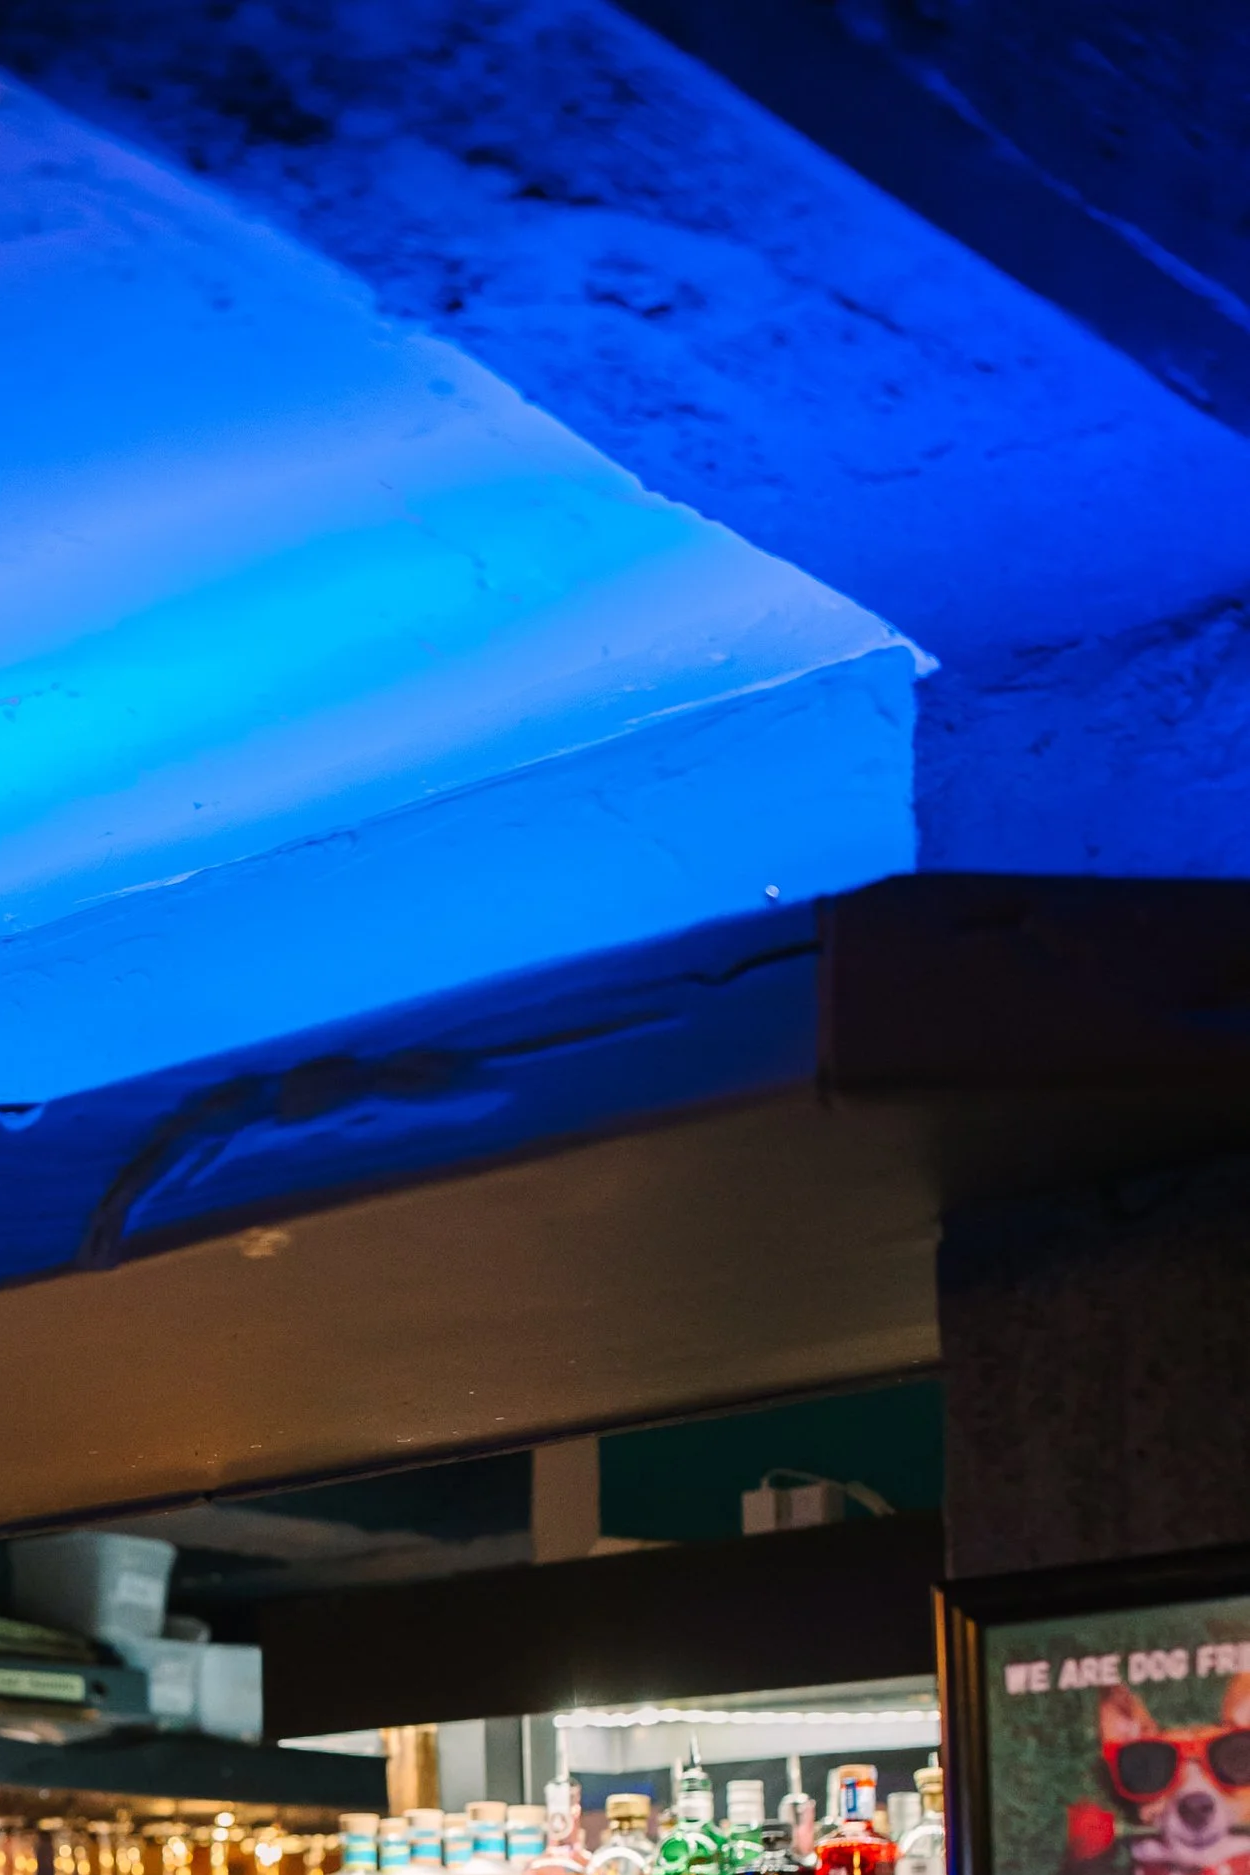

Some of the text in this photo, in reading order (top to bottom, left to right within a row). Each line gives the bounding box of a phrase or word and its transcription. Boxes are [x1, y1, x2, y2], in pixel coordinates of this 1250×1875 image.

[1005, 1660, 1050, 1695] WE
[1058, 1654, 1121, 1690] ARE
[1127, 1648, 1189, 1684] DOG
